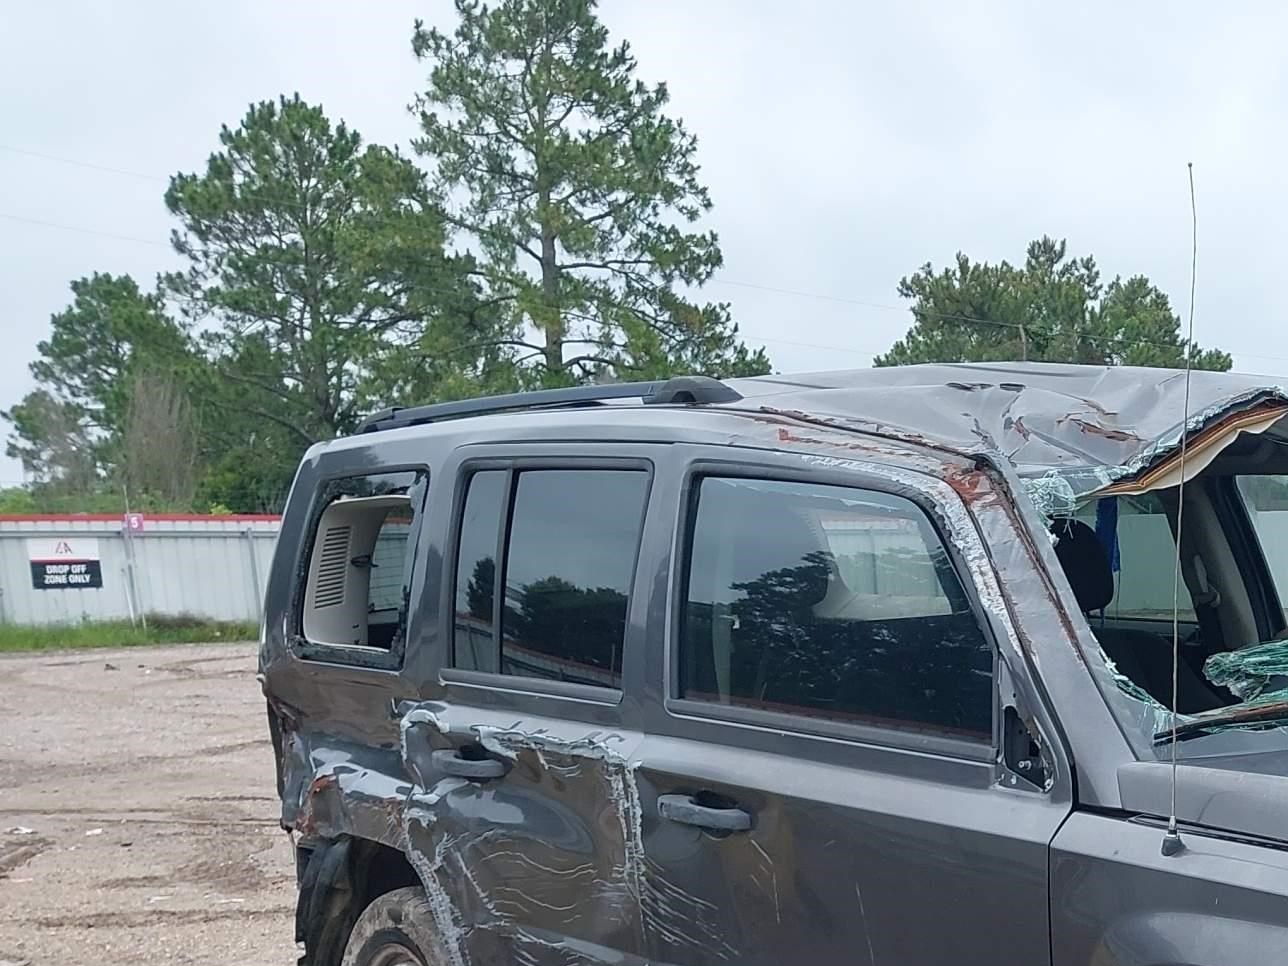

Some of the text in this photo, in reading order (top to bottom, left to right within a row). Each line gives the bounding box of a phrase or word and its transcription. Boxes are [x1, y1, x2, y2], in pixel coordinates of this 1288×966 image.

[130, 517, 139, 528] 5
[45, 564, 87, 574] DROP OFF
[44, 574, 91, 584] ZONE ONLY
